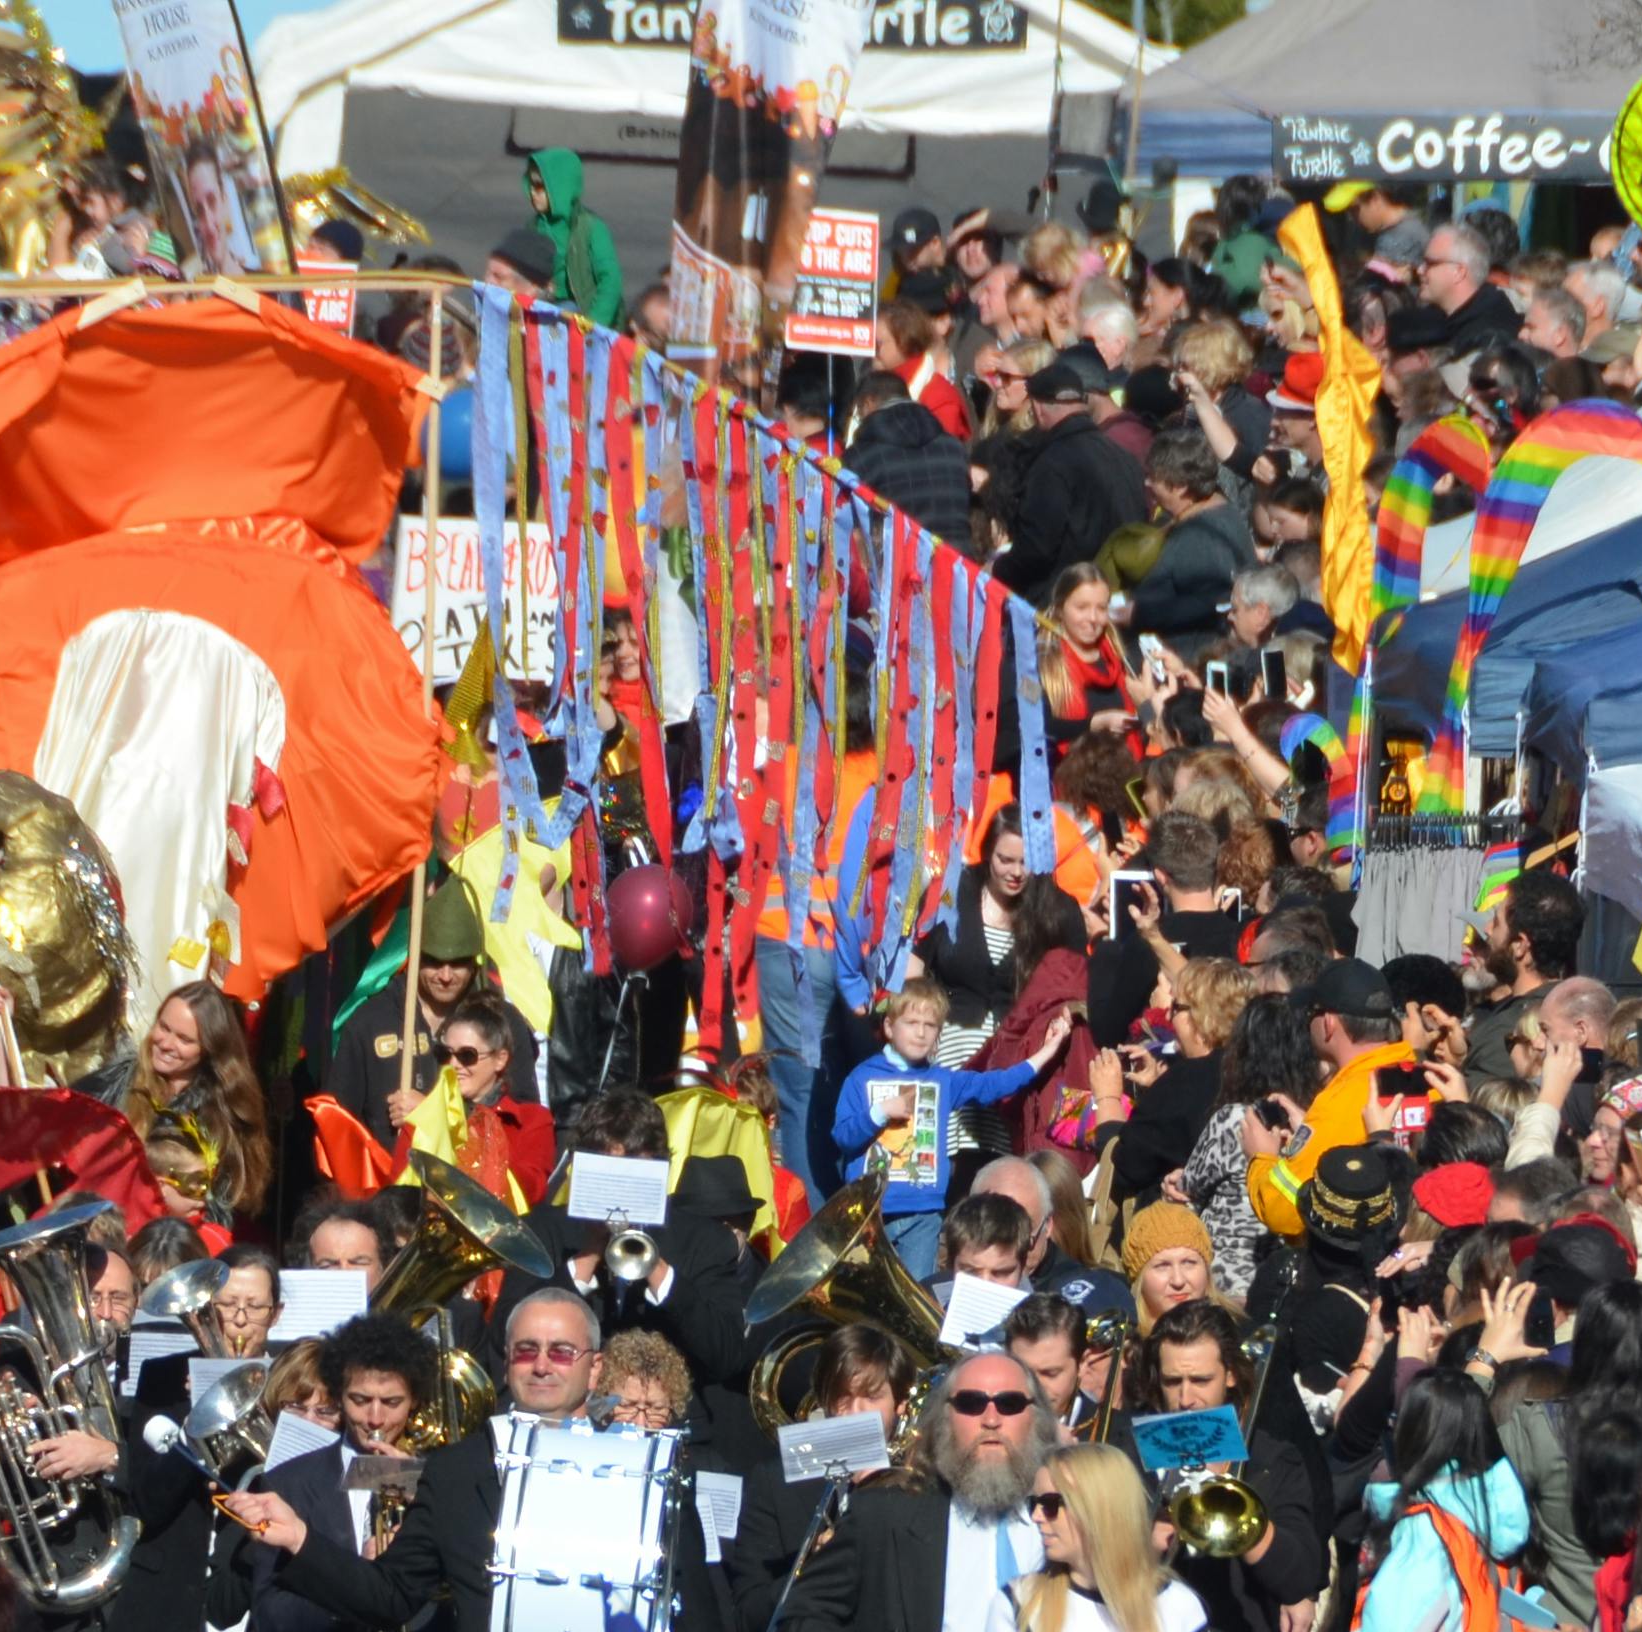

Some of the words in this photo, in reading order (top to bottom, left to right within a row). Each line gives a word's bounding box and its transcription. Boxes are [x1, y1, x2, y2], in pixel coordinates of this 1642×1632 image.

[142, 4, 191, 37] HOUSE
[607, 0, 694, 43] Tan
[862, 0, 970, 46] rtle
